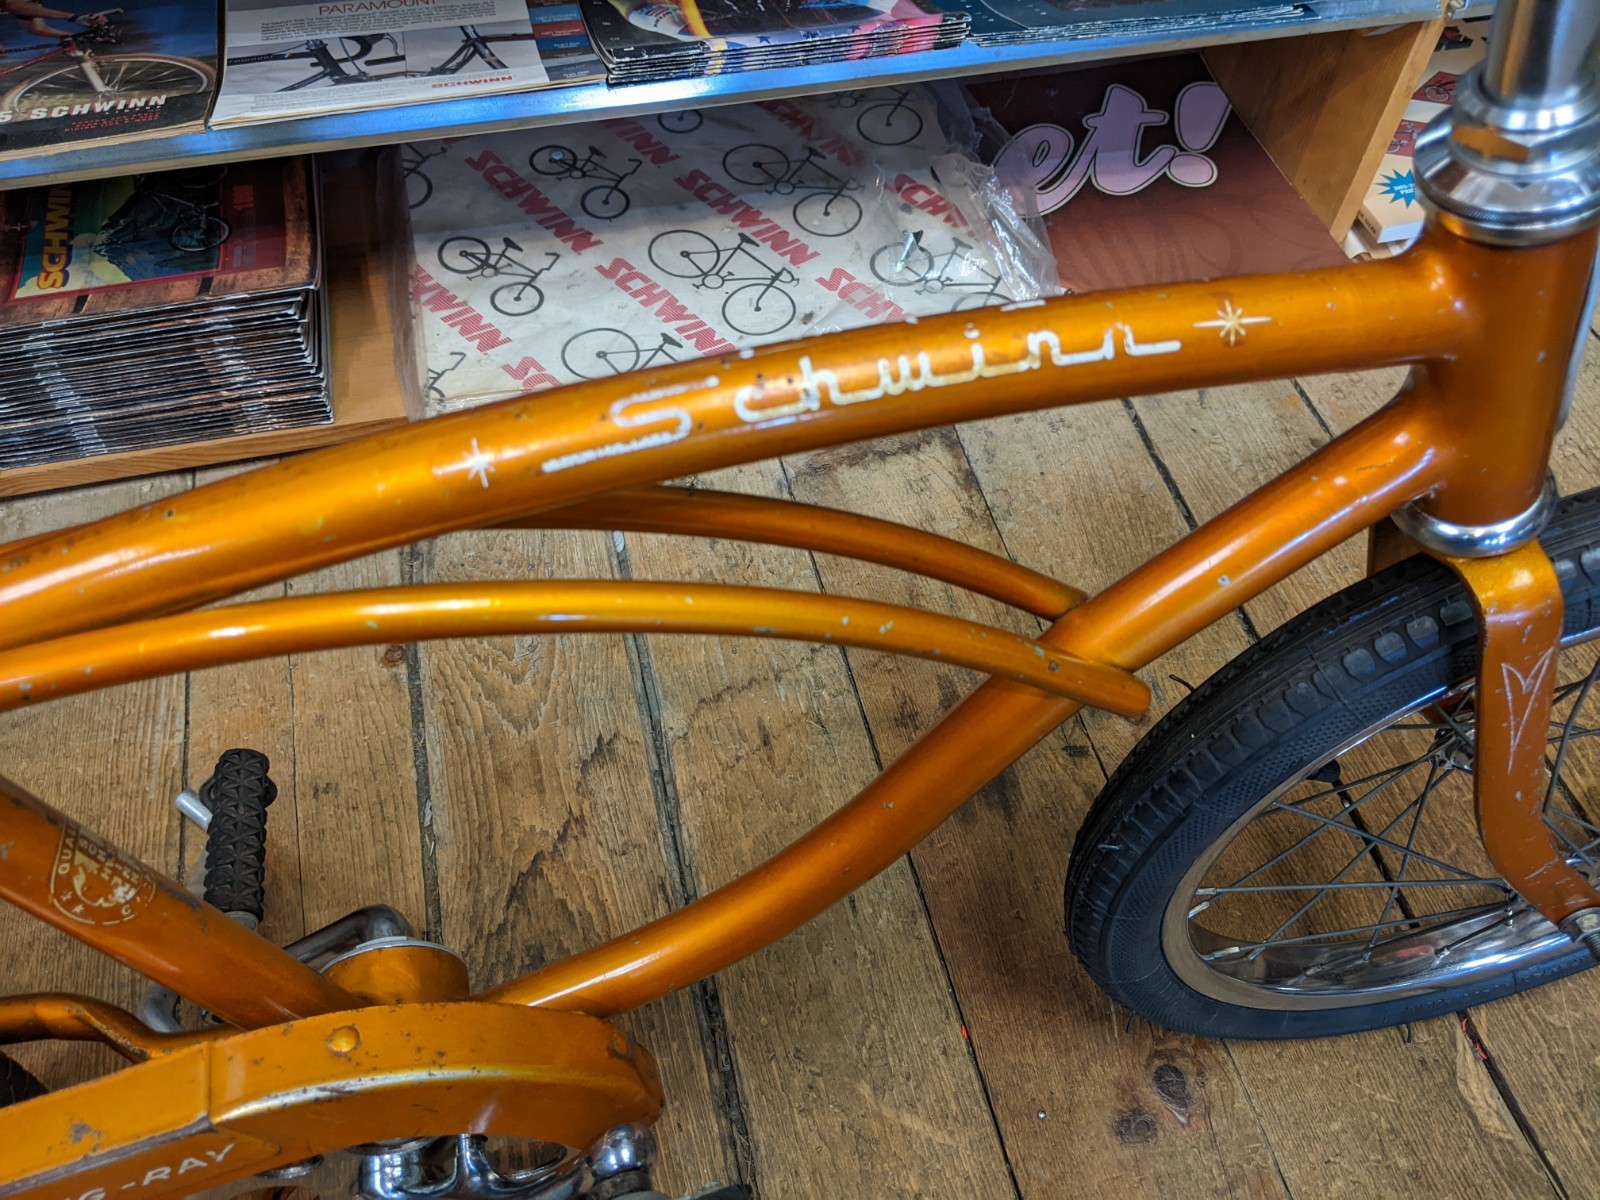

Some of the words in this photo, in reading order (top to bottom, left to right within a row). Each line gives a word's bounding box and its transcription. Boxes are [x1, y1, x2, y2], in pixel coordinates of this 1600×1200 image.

[30, 94, 167, 120] SCHWINN
[431, 75, 514, 90] SCHWINN
[464, 150, 605, 255] SCHWINN
[674, 169, 821, 269] SCHWINN
[541, 322, 1183, 474] Schwinn
